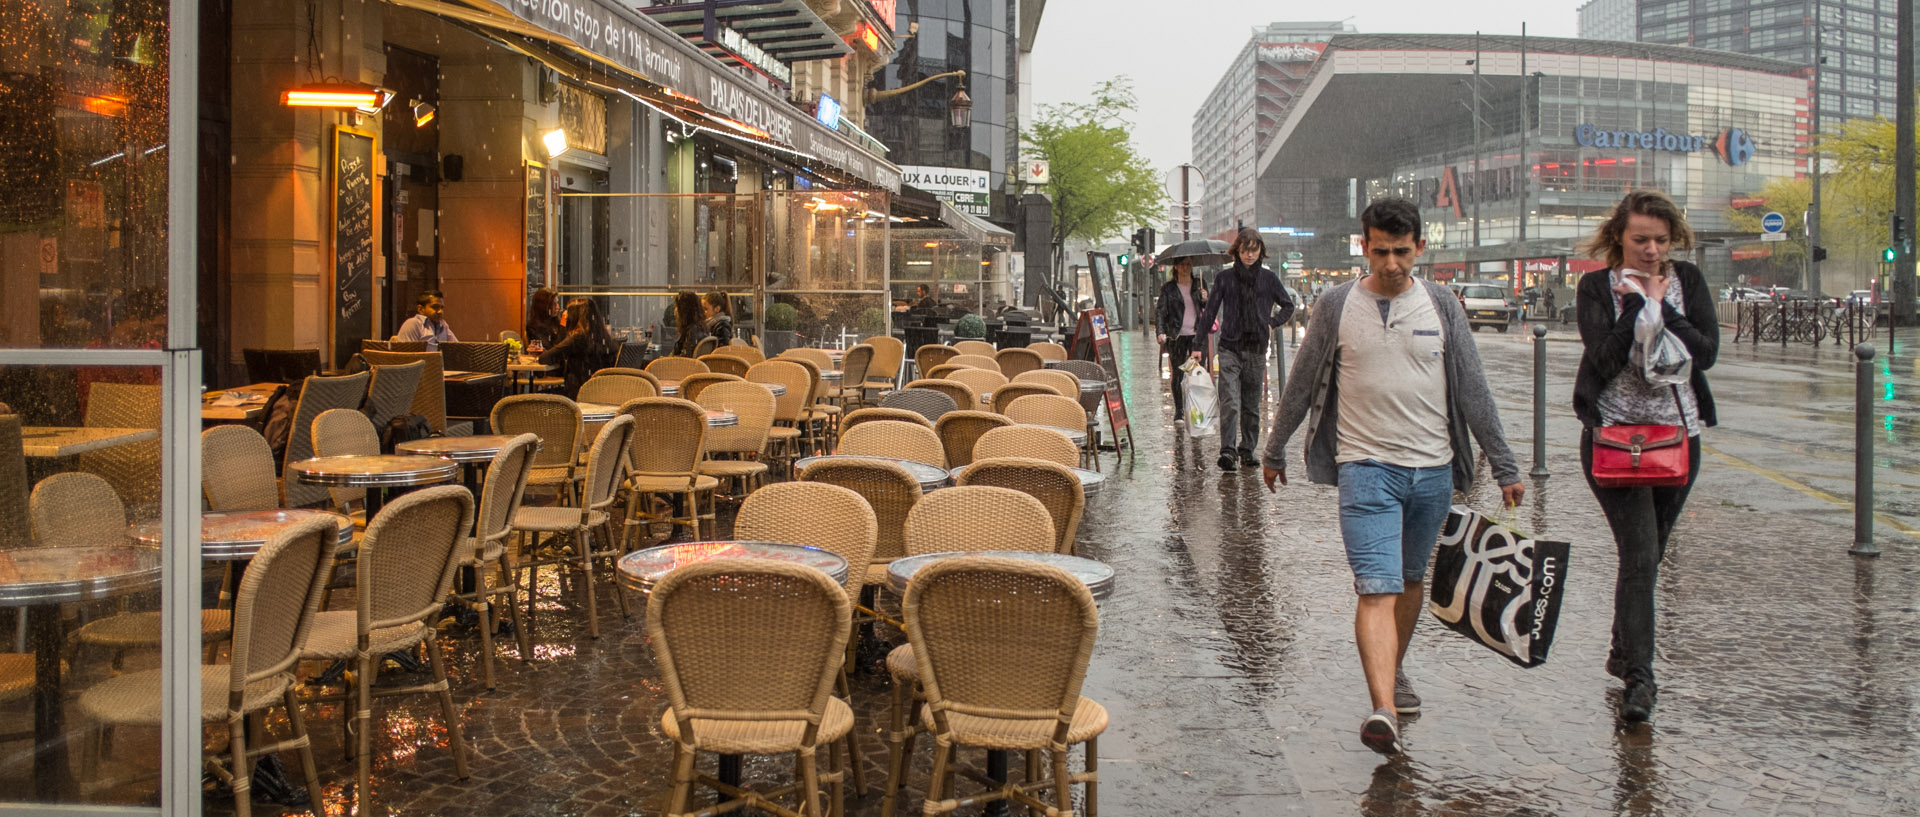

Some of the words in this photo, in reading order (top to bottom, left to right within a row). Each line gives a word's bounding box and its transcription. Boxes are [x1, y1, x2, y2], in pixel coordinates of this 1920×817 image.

[542, 0, 570, 25] non
[573, 6, 600, 49] stop
[604, 16, 619, 49] de
[710, 76, 745, 119] PALAIS
[745, 95, 758, 127] DE
[1576, 123, 1706, 153] Carrefour
[902, 173, 920, 184] UX
[923, 175, 932, 184] A
[935, 175, 969, 186] LOUER
[955, 192, 975, 203] CBRE
